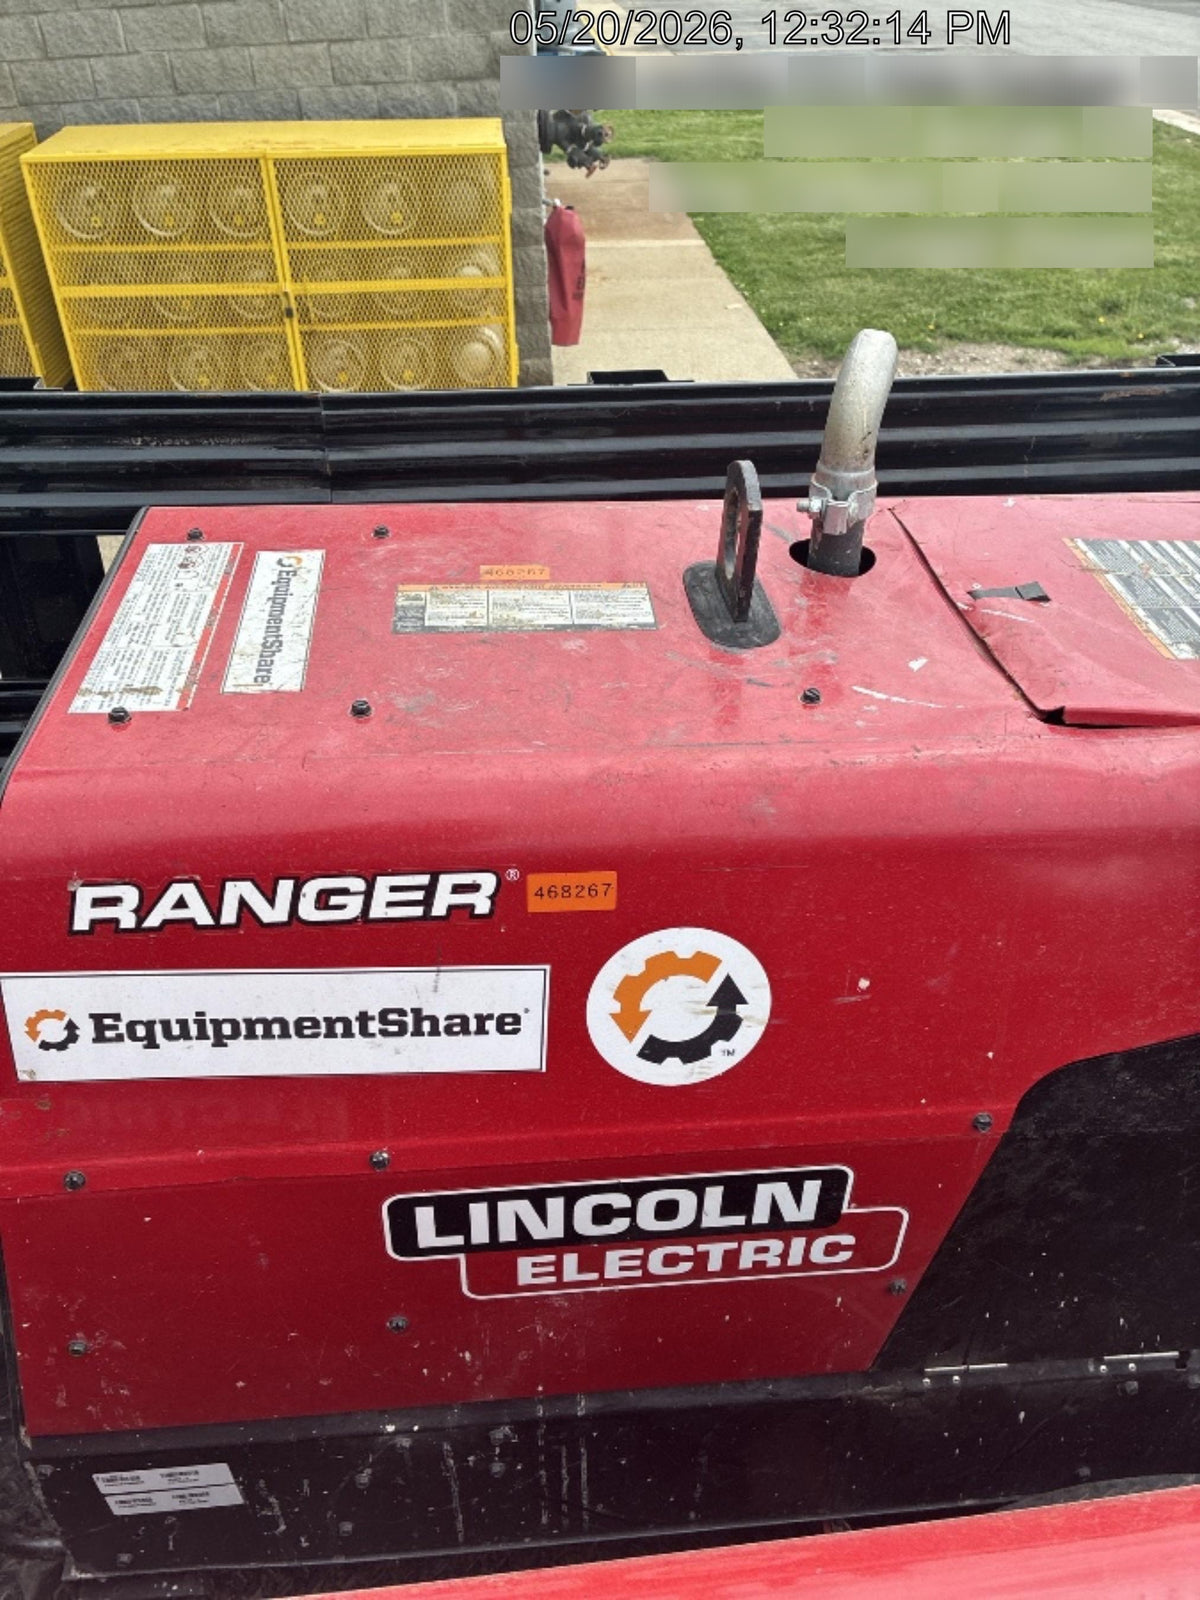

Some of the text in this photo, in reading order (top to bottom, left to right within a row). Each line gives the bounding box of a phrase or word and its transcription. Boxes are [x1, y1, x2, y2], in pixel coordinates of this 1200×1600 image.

[254, 569, 298, 684] EquipmentShare
[534, 882, 613, 900] 468267
[89, 1007, 523, 1050] EquipmentShare
[414, 1179, 823, 1249] LINCOLN
[516, 1233, 857, 1287] ELECTRIC
